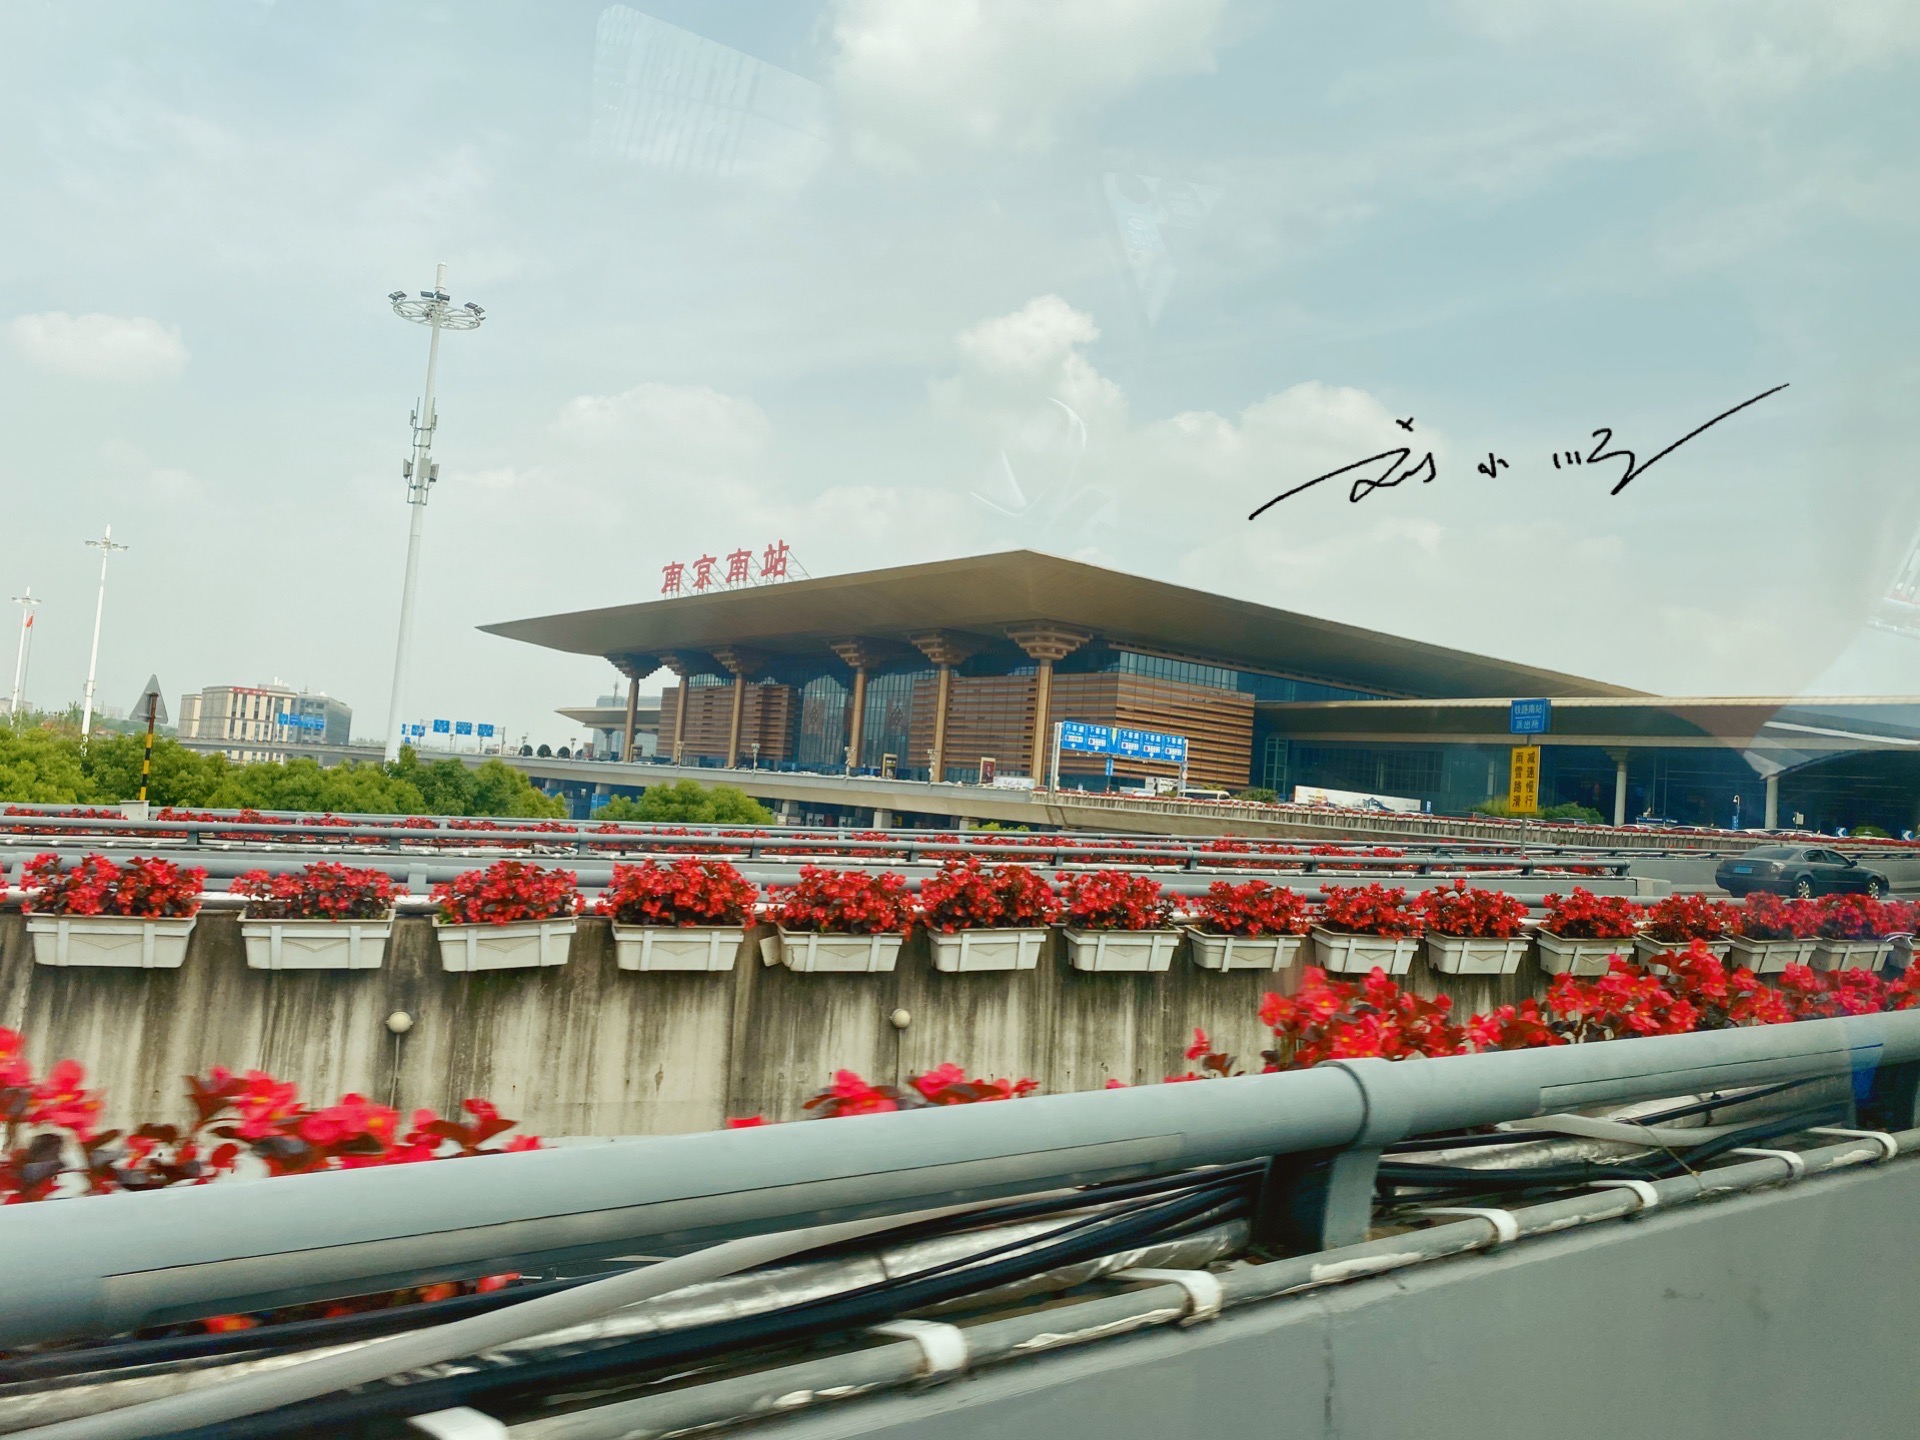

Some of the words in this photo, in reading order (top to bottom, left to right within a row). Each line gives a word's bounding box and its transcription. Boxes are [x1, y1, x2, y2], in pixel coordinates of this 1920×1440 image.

[661, 539, 790, 594] 南京南站
[1514, 704, 1542, 715] 铁路南站
[1516, 719, 1539, 730] 派出所
[1512, 752, 1524, 808] 雨雪路滑
[1524, 752, 1536, 808] 减速慢行
